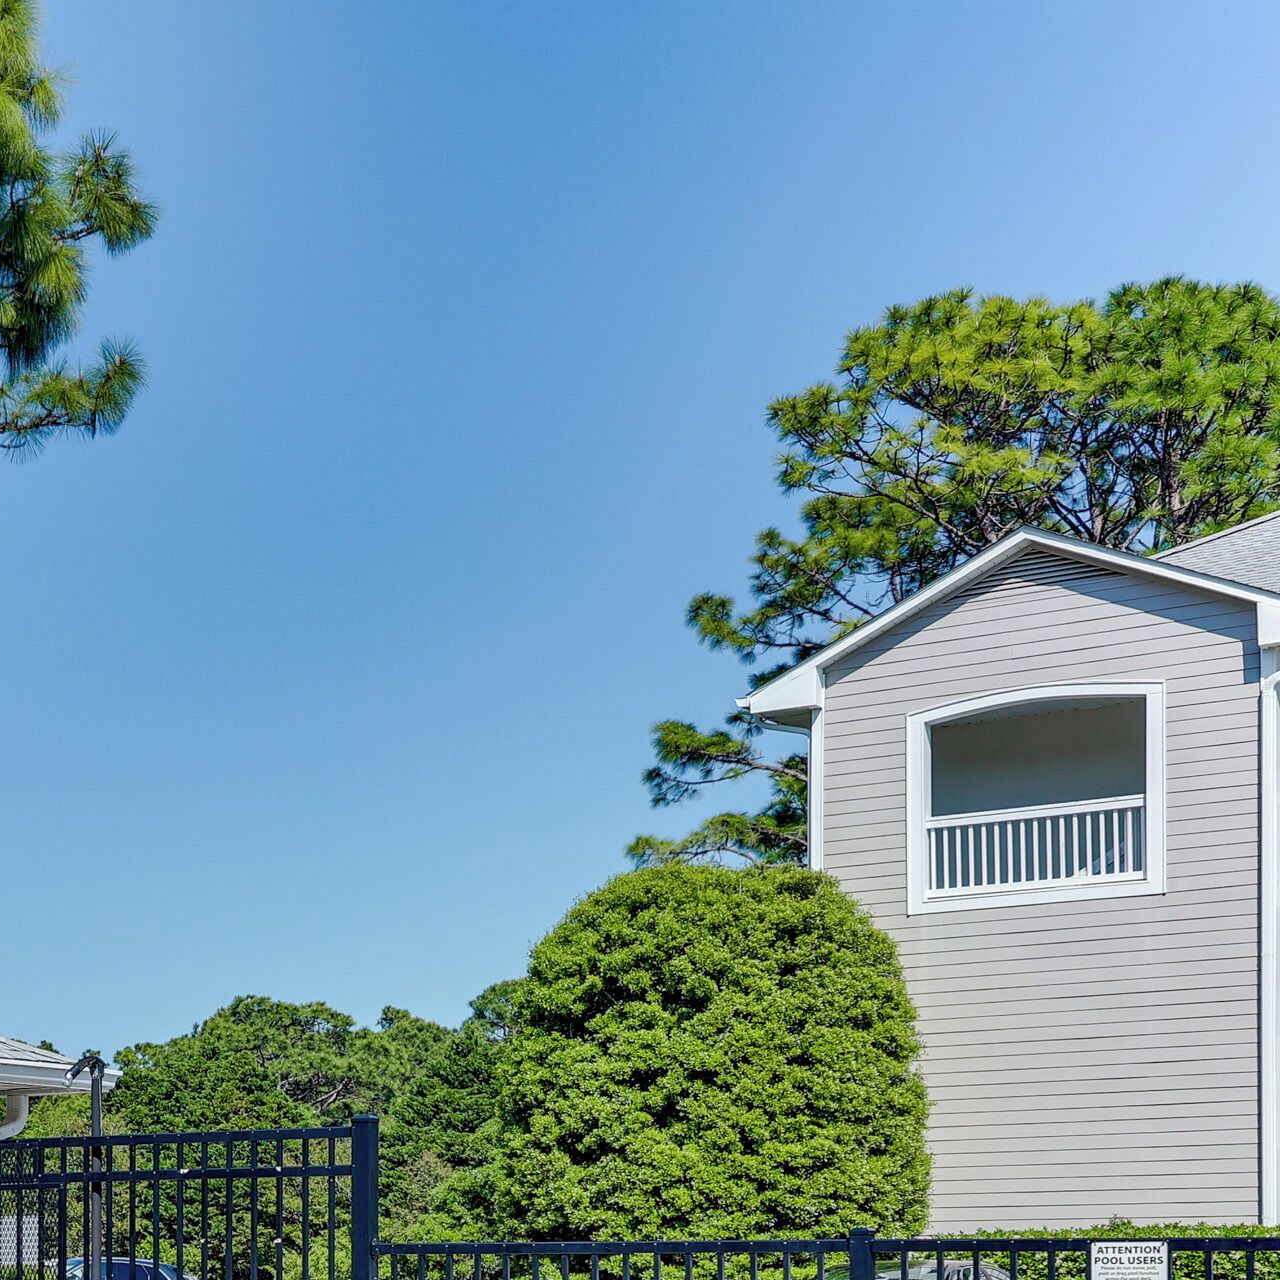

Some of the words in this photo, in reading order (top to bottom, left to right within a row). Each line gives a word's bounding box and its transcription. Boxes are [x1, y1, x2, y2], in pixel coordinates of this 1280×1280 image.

[1096, 1246, 1161, 1254] ATTENTION
[1094, 1256, 1125, 1265] POOL
[1128, 1256, 1164, 1265] USERS
